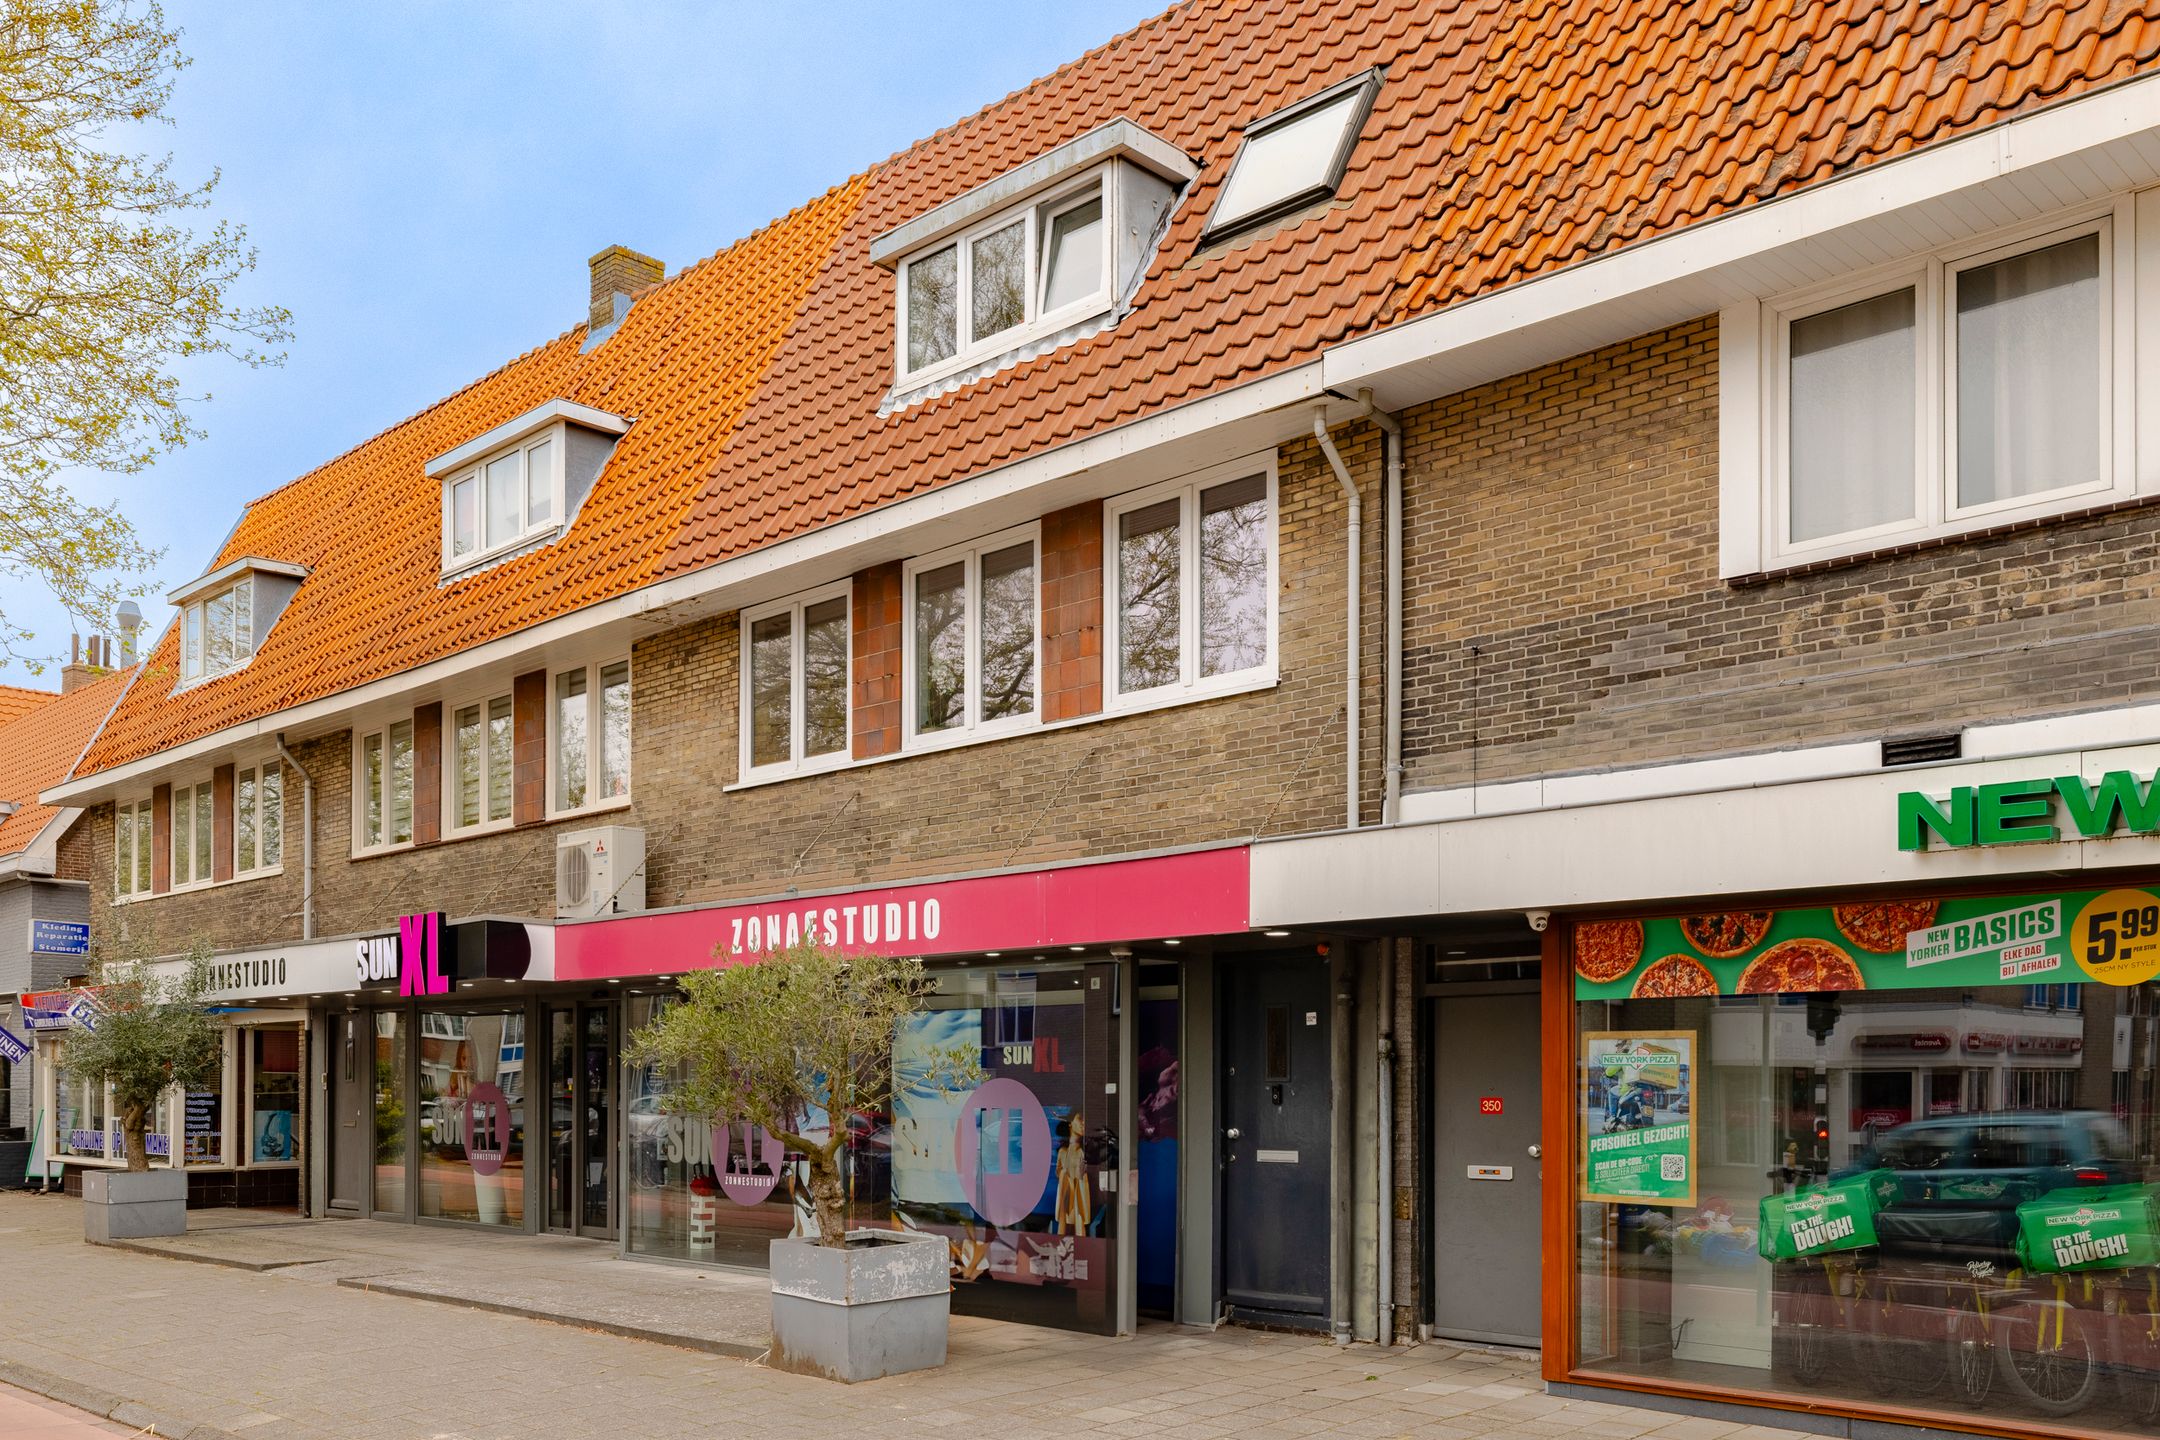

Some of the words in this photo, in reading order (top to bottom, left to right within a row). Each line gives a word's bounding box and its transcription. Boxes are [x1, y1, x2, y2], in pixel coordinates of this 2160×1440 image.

[1898, 767, 2160, 851] NEW
[36, 931, 88, 942] Reparatie
[41, 923, 83, 934] Kleding
[1927, 928, 1950, 943] NEW
[1954, 906, 2055, 952] BASICS
[2087, 905, 2159, 964] 5.99
[38, 943, 85, 954] Stomerij
[356, 936, 398, 982] SUN
[399, 911, 449, 997] XL
[1910, 943, 1950, 962] YORKER
[2003, 948, 2022, 961] ELKE
[2024, 944, 2042, 957] DAG
[2002, 965, 2015, 977] BIJ
[2021, 957, 2057, 973] AFHALEN
[2094, 966, 2116, 975] 25CM
[2117, 962, 2130, 971] NY
[2131, 959, 2157, 969] STYLE
[1003, 1046, 1032, 1065] SUN
[1033, 1037, 1065, 1073] XL
[1603, 1056, 1624, 1064] NEW
[1625, 1056, 1648, 1064] YORK
[1649, 1056, 1676, 1064] PIZZA
[1482, 1100, 1502, 1112] 350
[71, 1130, 104, 1151] GORDIJNE
[1590, 1132, 1641, 1153] PERSONEEL
[1643, 1124, 1689, 1144] GEZOCHT!
[1786, 1203, 1802, 1211] NEW
[1823, 1195, 1844, 1205] PIZZA
[1791, 1220, 1807, 1233] IT'S
[1808, 1214, 1824, 1228] THE
[2069, 1214, 2092, 1222] YORK
[2094, 1211, 2119, 1220] PIZZA
[1793, 1215, 1855, 1252] DOUGH!
[2052, 1236, 2072, 1249] IT'S
[2074, 1230, 2092, 1243] THE
[2055, 1233, 2129, 1268] DOUGH!
